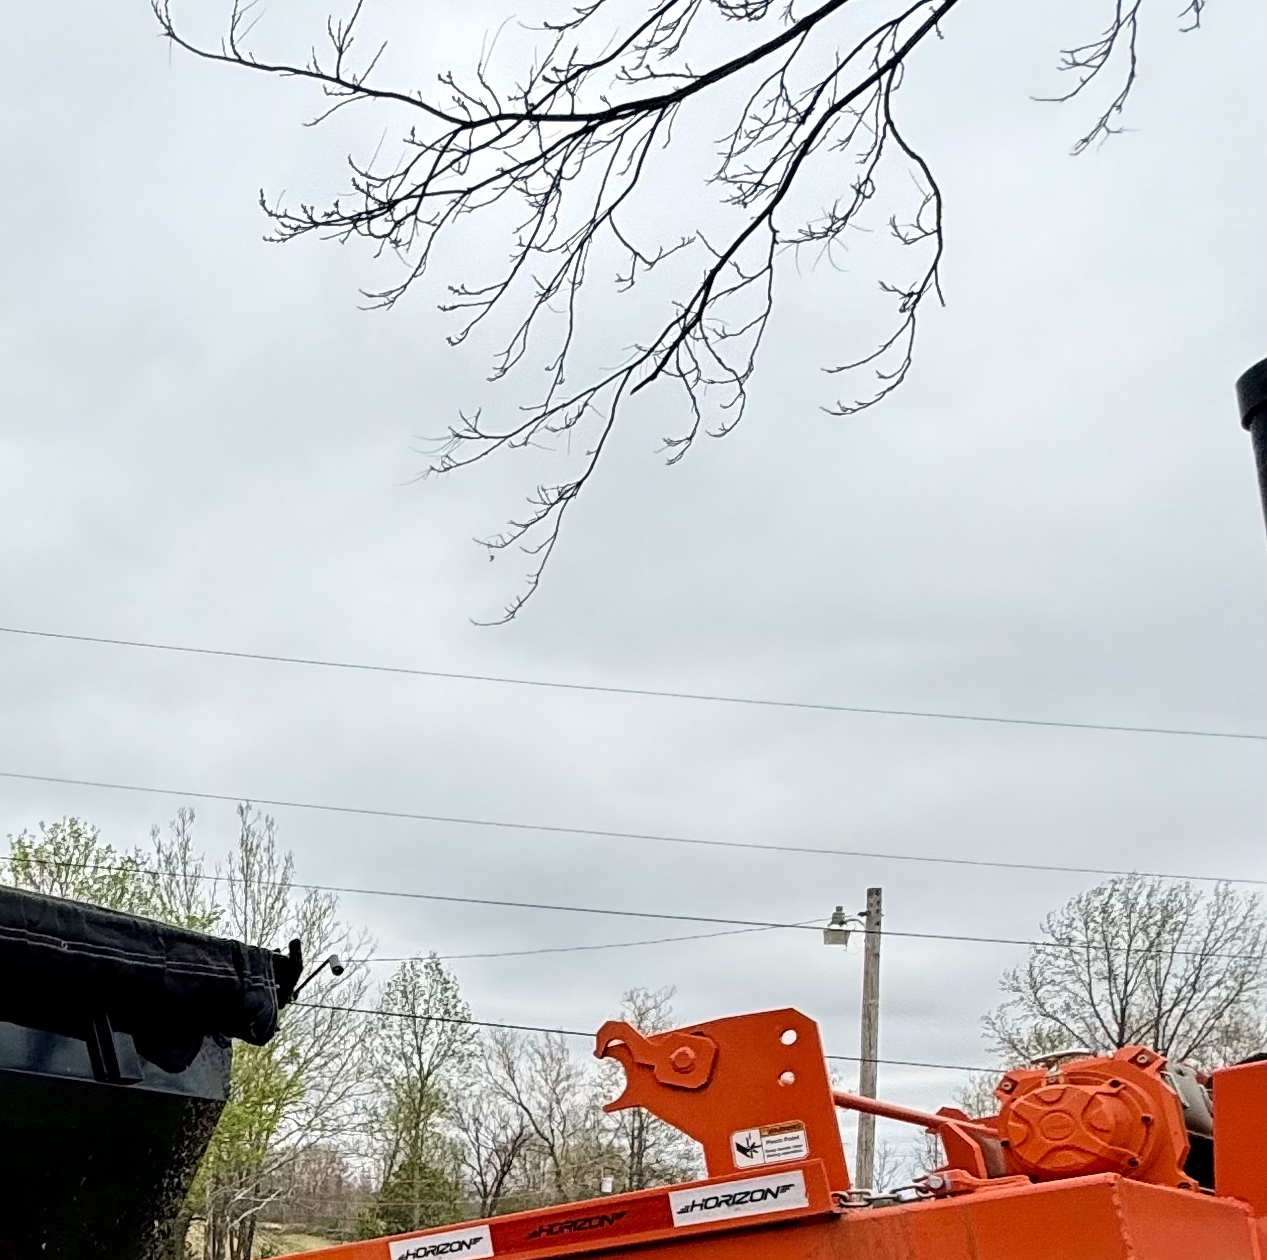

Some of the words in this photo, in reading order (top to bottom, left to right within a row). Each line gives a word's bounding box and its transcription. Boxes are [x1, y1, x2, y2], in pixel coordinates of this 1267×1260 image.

[687, 1186, 784, 1213] HORIZON
[537, 1213, 616, 1237] HORIZON
[403, 1239, 474, 1260] HORIZON
